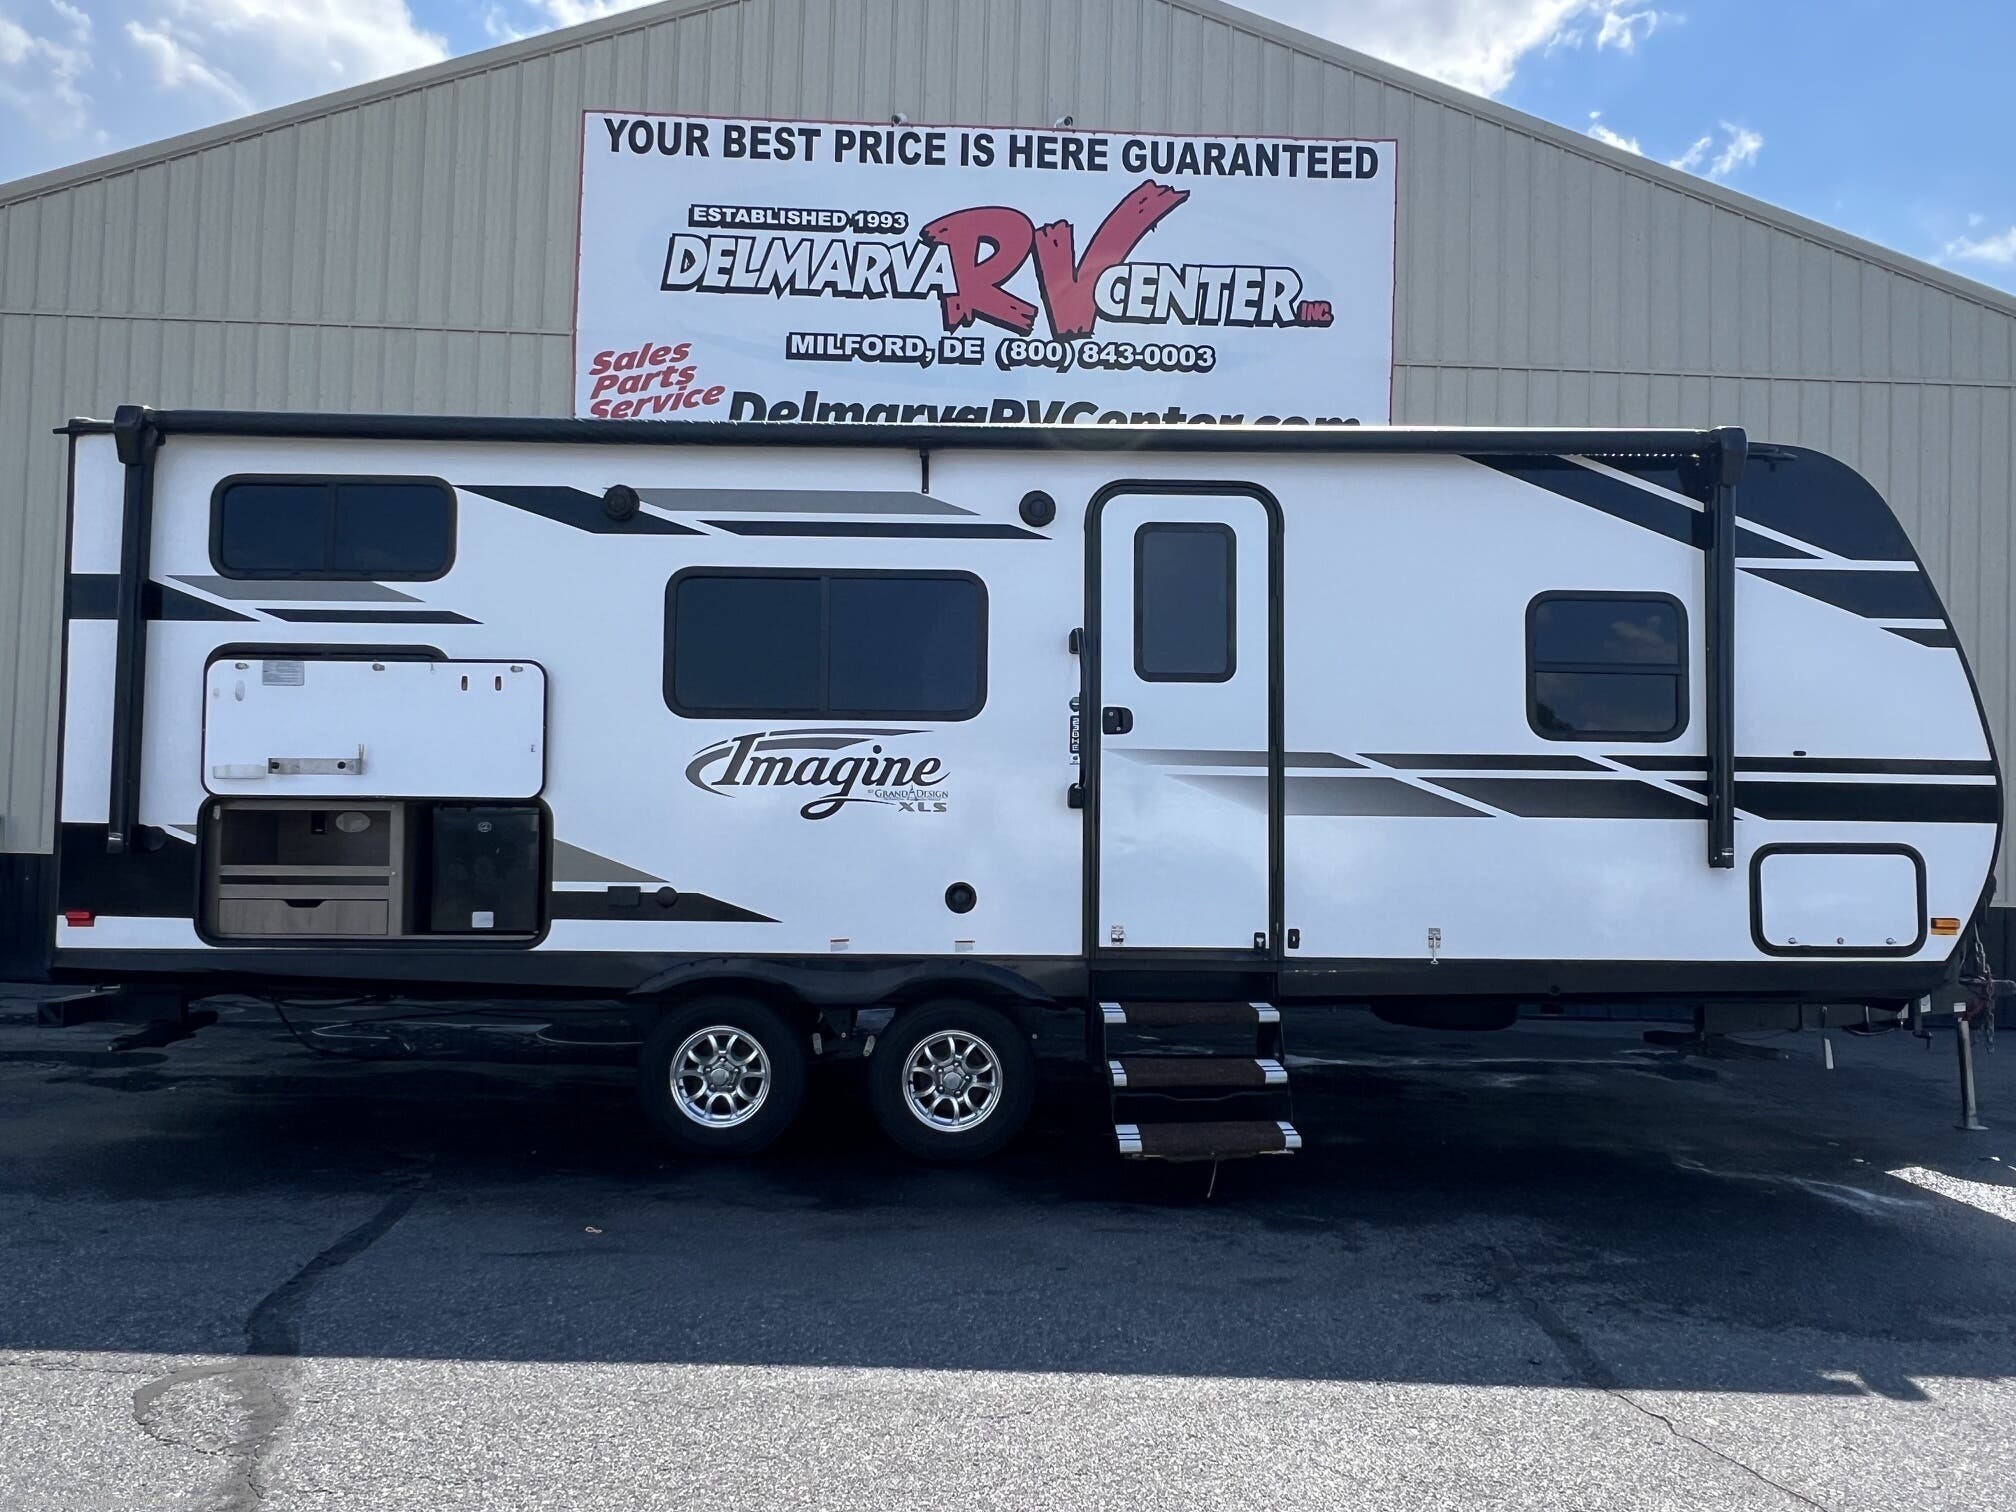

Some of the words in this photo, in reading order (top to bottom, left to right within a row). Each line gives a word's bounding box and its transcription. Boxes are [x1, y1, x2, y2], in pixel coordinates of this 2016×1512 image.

[603, 118, 710, 158] YOUR
[722, 124, 821, 162] BEST
[834, 129, 946, 166] PRICE
[960, 132, 995, 167] IS
[1008, 134, 1109, 172] HERE
[1121, 139, 1379, 180] GUARANTEED
[690, 205, 847, 231] ESTABLISHED
[851, 211, 908, 234] 1993
[661, 233, 959, 299] DELMARVA
[921, 179, 1191, 340] RV
[1093, 262, 1304, 327] CENTER
[589, 343, 692, 376] Sales
[787, 332, 935, 367] MILFORD,
[939, 335, 985, 365] DE
[997, 340, 1075, 372] (800)
[1079, 343, 1216, 373] 843-0003
[590, 366, 698, 400] Parts
[590, 386, 726, 419] Service
[729, 391, 1361, 426] DelmarvaRVC
[711, 731, 951, 820] Imagine
[874, 788, 908, 798] GRAND
[916, 789, 949, 798] DESIGN
[898, 801, 947, 813] XLS
